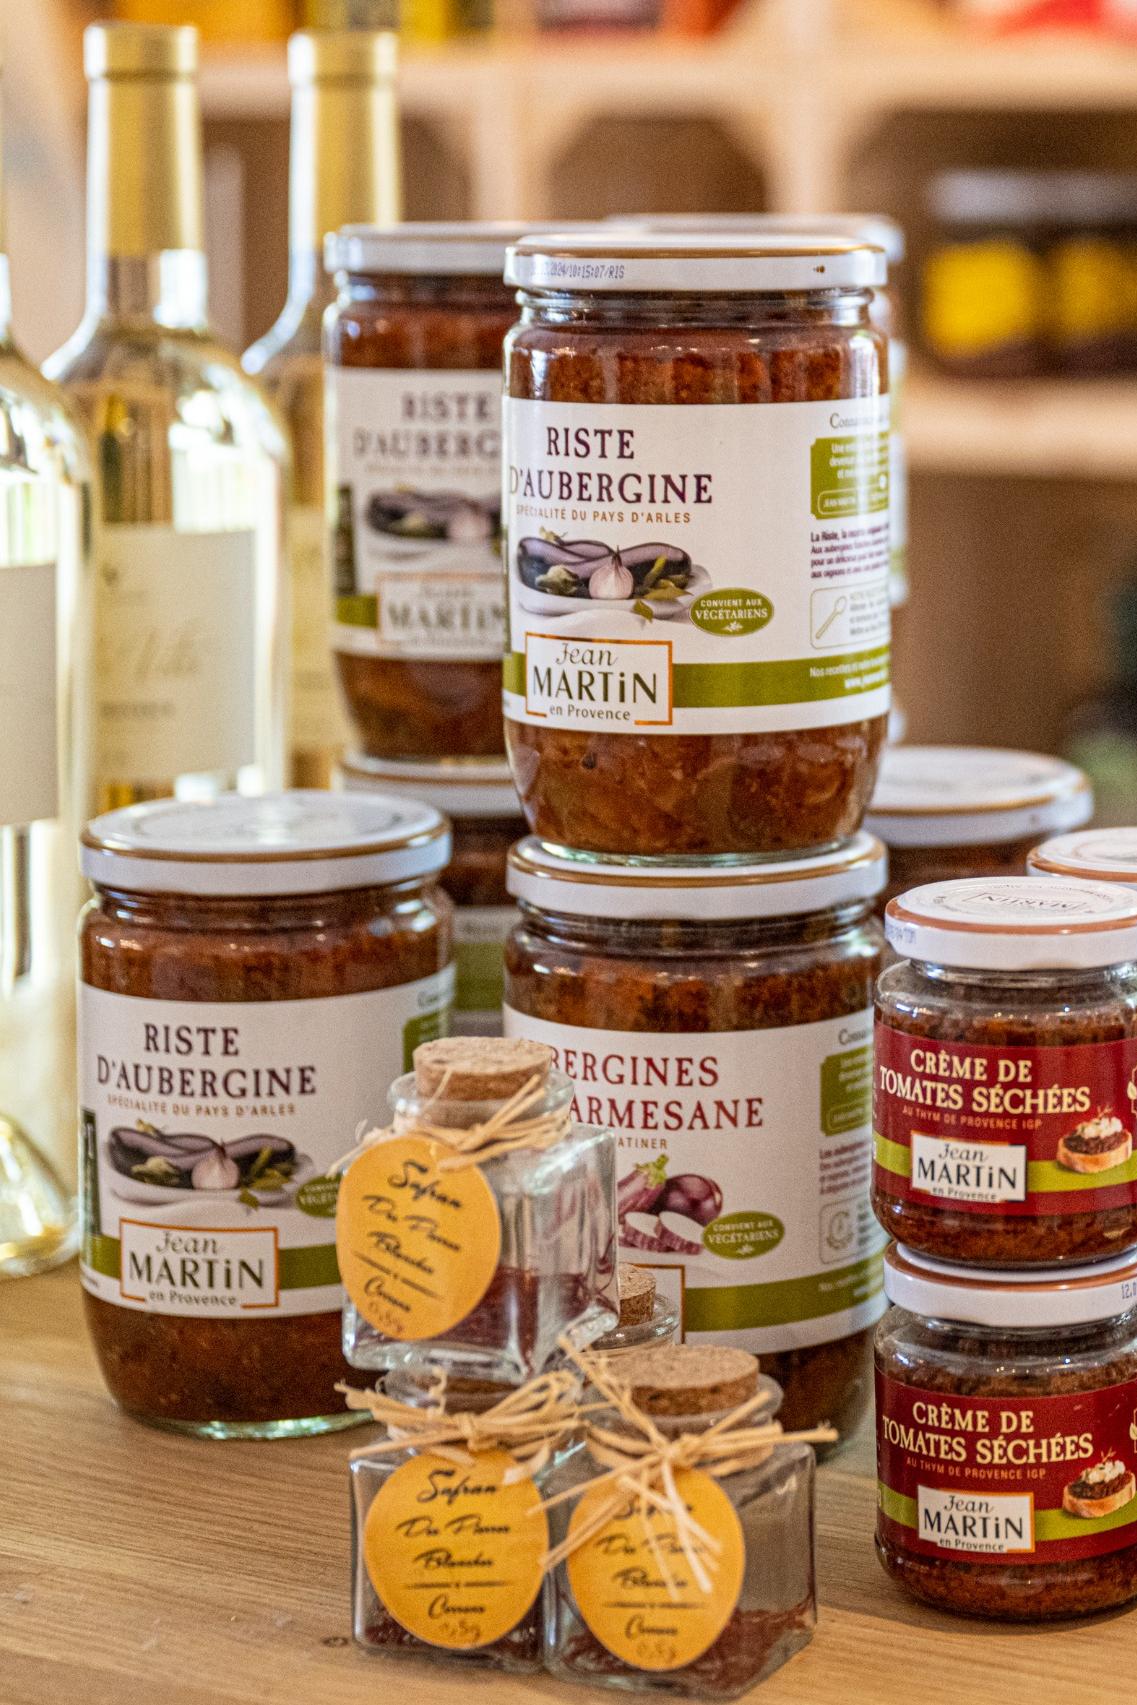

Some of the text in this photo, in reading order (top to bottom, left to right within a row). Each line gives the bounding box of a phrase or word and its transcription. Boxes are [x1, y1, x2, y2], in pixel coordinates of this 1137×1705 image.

[354, 428, 499, 459] D'AUBERG
[546, 426, 635, 460] RISTE
[509, 466, 713, 504] D'AUBERGINE
[571, 508, 587, 521] DU
[593, 510, 625, 523] PAYS
[631, 511, 691, 524] D'ARLES
[694, 607, 769, 621] VÉGÉTARIENS
[700, 596, 763, 609] CONVIENT AUX
[555, 641, 619, 667] Jean
[549, 704, 631, 722] en Provence
[144, 1022, 240, 1057] RISTE
[97, 1054, 317, 1099] D'AUBERGINE
[550, 1046, 720, 1088] BERGINES
[910, 1049, 1033, 1084] CRÈME DE
[879, 1065, 1092, 1115] TOMATES SÉCHÉES
[172, 1103, 190, 1116] DU
[196, 1105, 229, 1118] PAYS
[236, 1102, 298, 1117] D'ARLES
[569, 1094, 764, 1131] ARMESANE
[902, 1105, 1043, 1131] AU THYM DE PROVENCE IGP
[617, 1136, 669, 1150] ATINER
[937, 1143, 990, 1163] Jean
[931, 1185, 997, 1201] en Provence
[707, 1228, 780, 1245] VÉGÉTARIENS
[712, 1219, 774, 1233] CONVIENT AUX
[155, 1231, 219, 1255] Jean
[149, 1291, 237, 1307] en Provence
[912, 1400, 1035, 1434] CRÈME DE
[882, 1415, 1095, 1465] TOMATES SÉCHÉES
[906, 1456, 1047, 1481] AU THYM DE PROVENCE IGP
[416, 1468, 499, 1506] Safran
[943, 1493, 995, 1514] Jean
[938, 1536, 1004, 1552] en Provence
